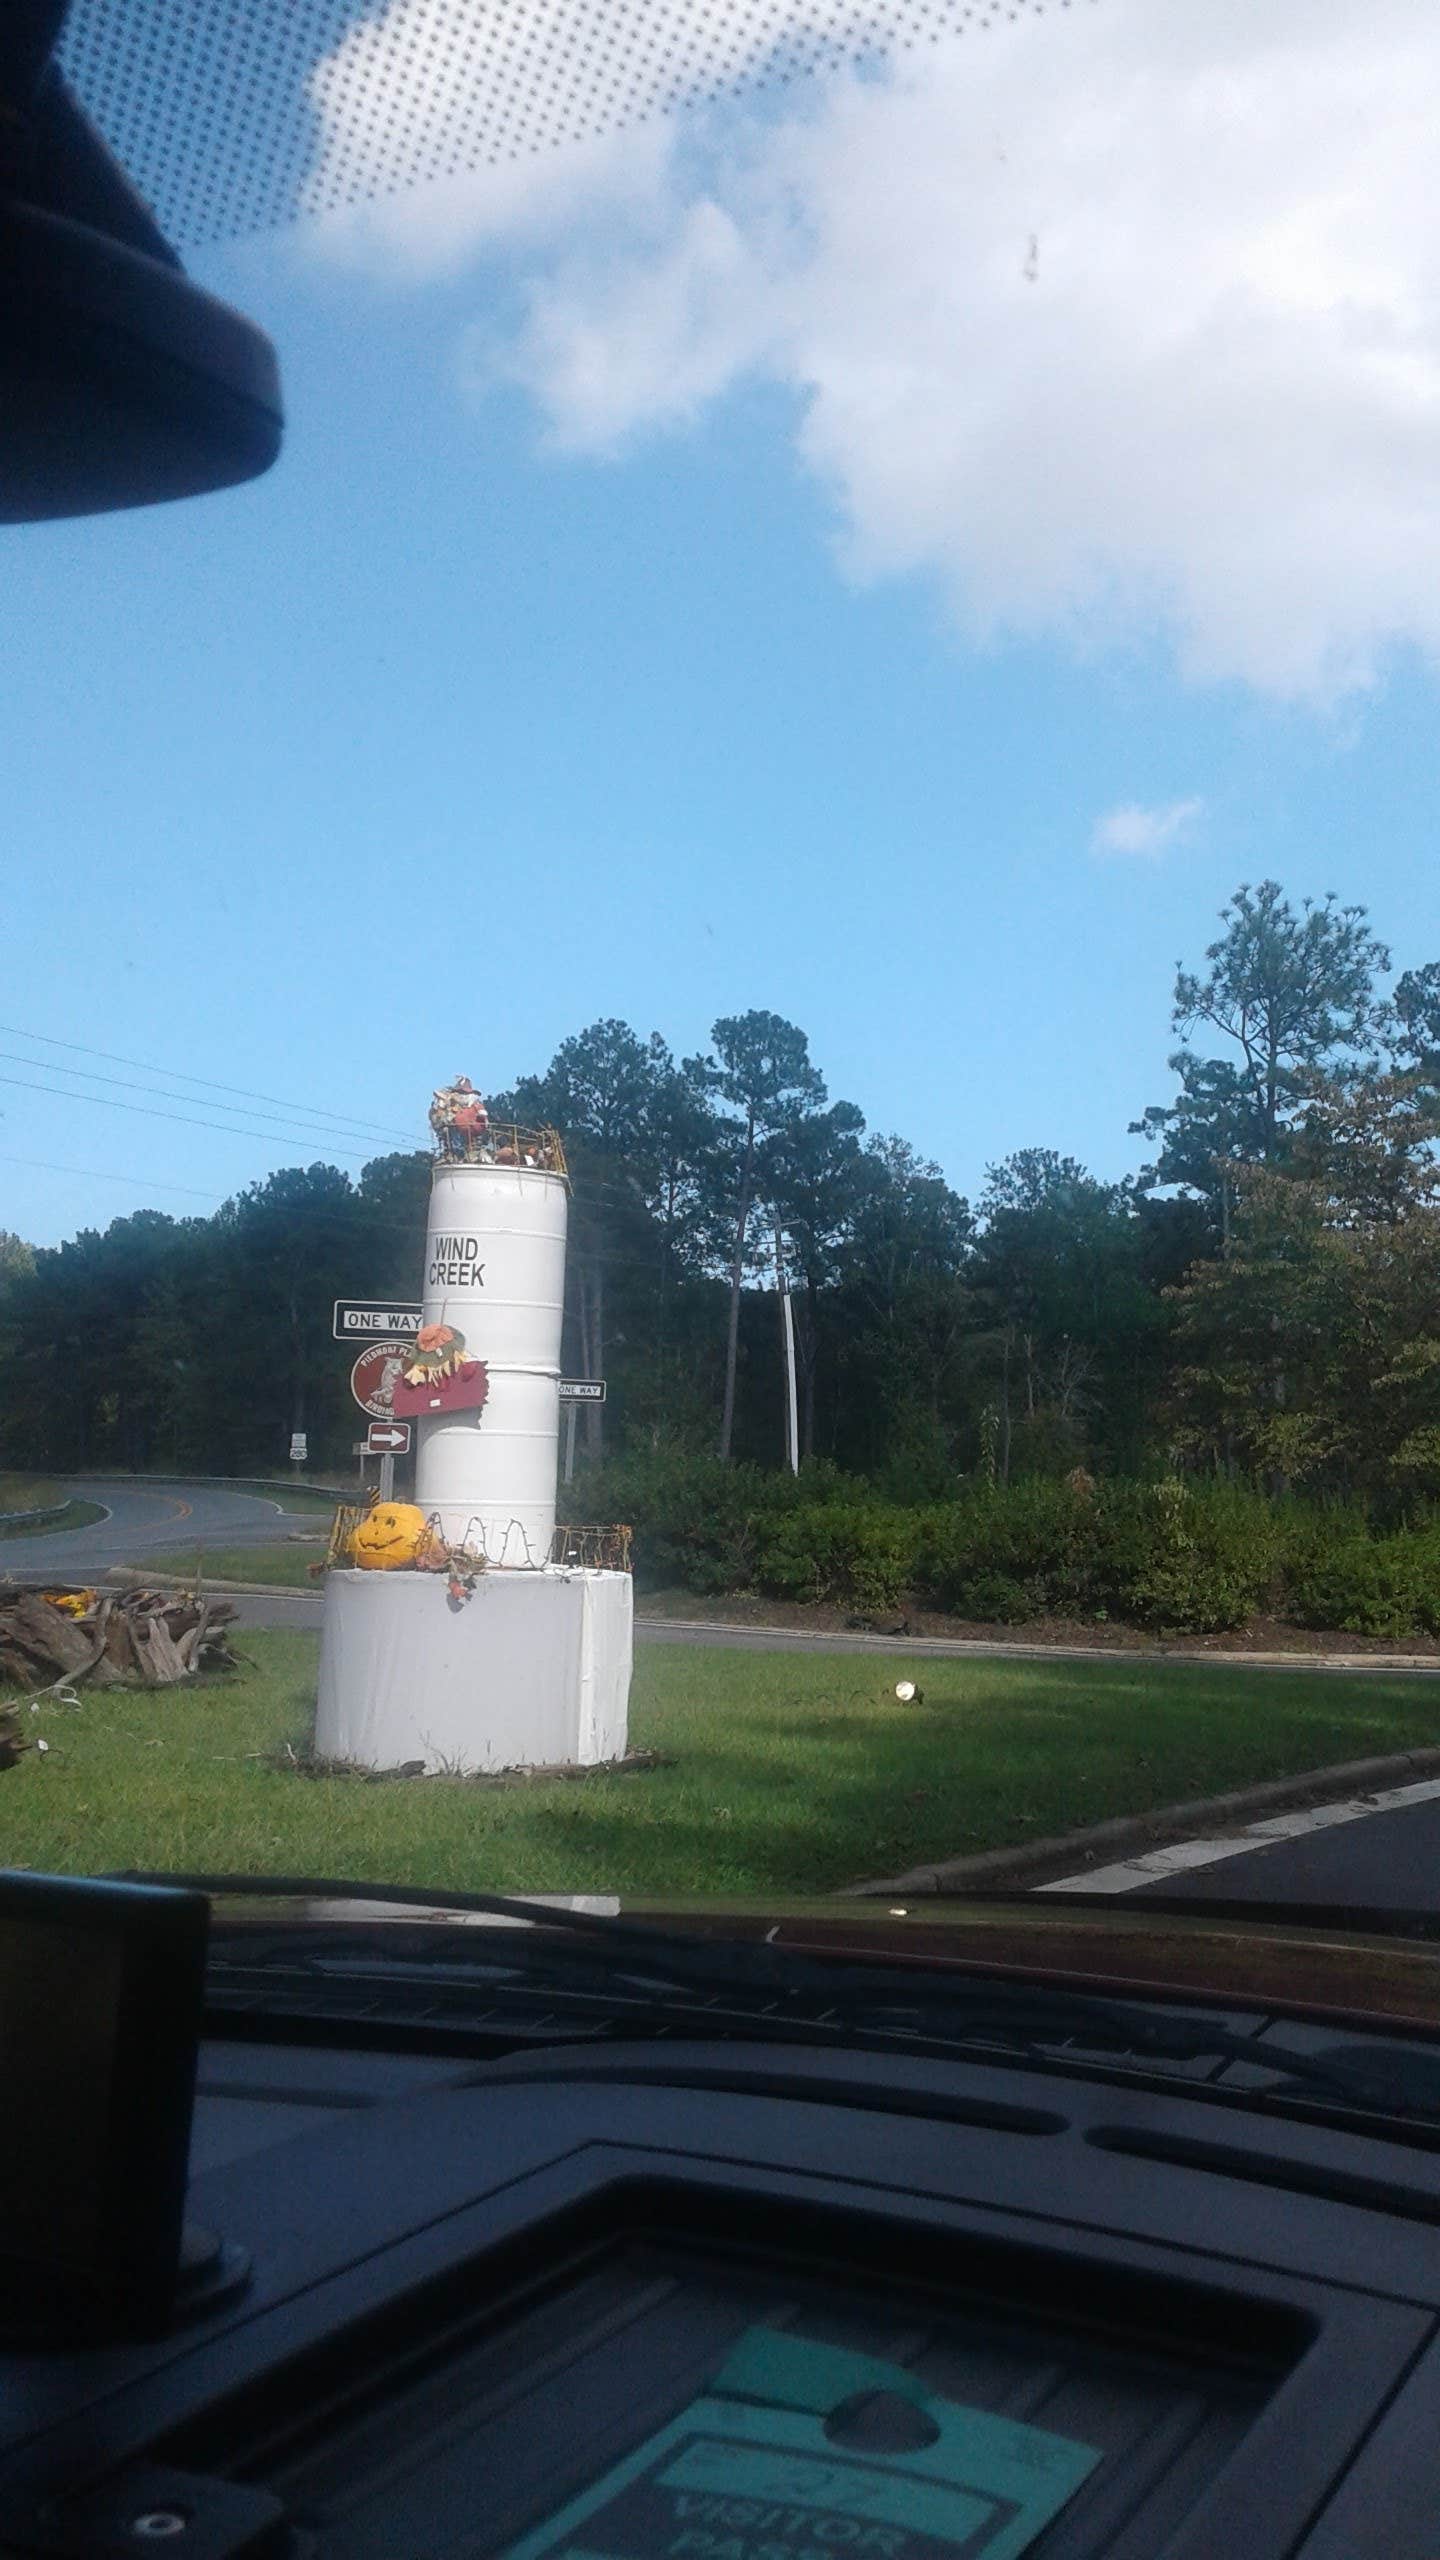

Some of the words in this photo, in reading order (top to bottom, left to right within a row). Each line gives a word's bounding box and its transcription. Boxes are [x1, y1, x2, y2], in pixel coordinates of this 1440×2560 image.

[435, 1237, 478, 1261] WIND
[428, 1263, 486, 1287] CREEK
[348, 1313, 381, 1327] ONE
[388, 1313, 422, 1329] WAY
[361, 1346, 397, 1367] PIEDMONT
[559, 1385, 576, 1394] ONE
[580, 1386, 599, 1395] WAY
[673, 2493, 906, 2556] VISITOR
